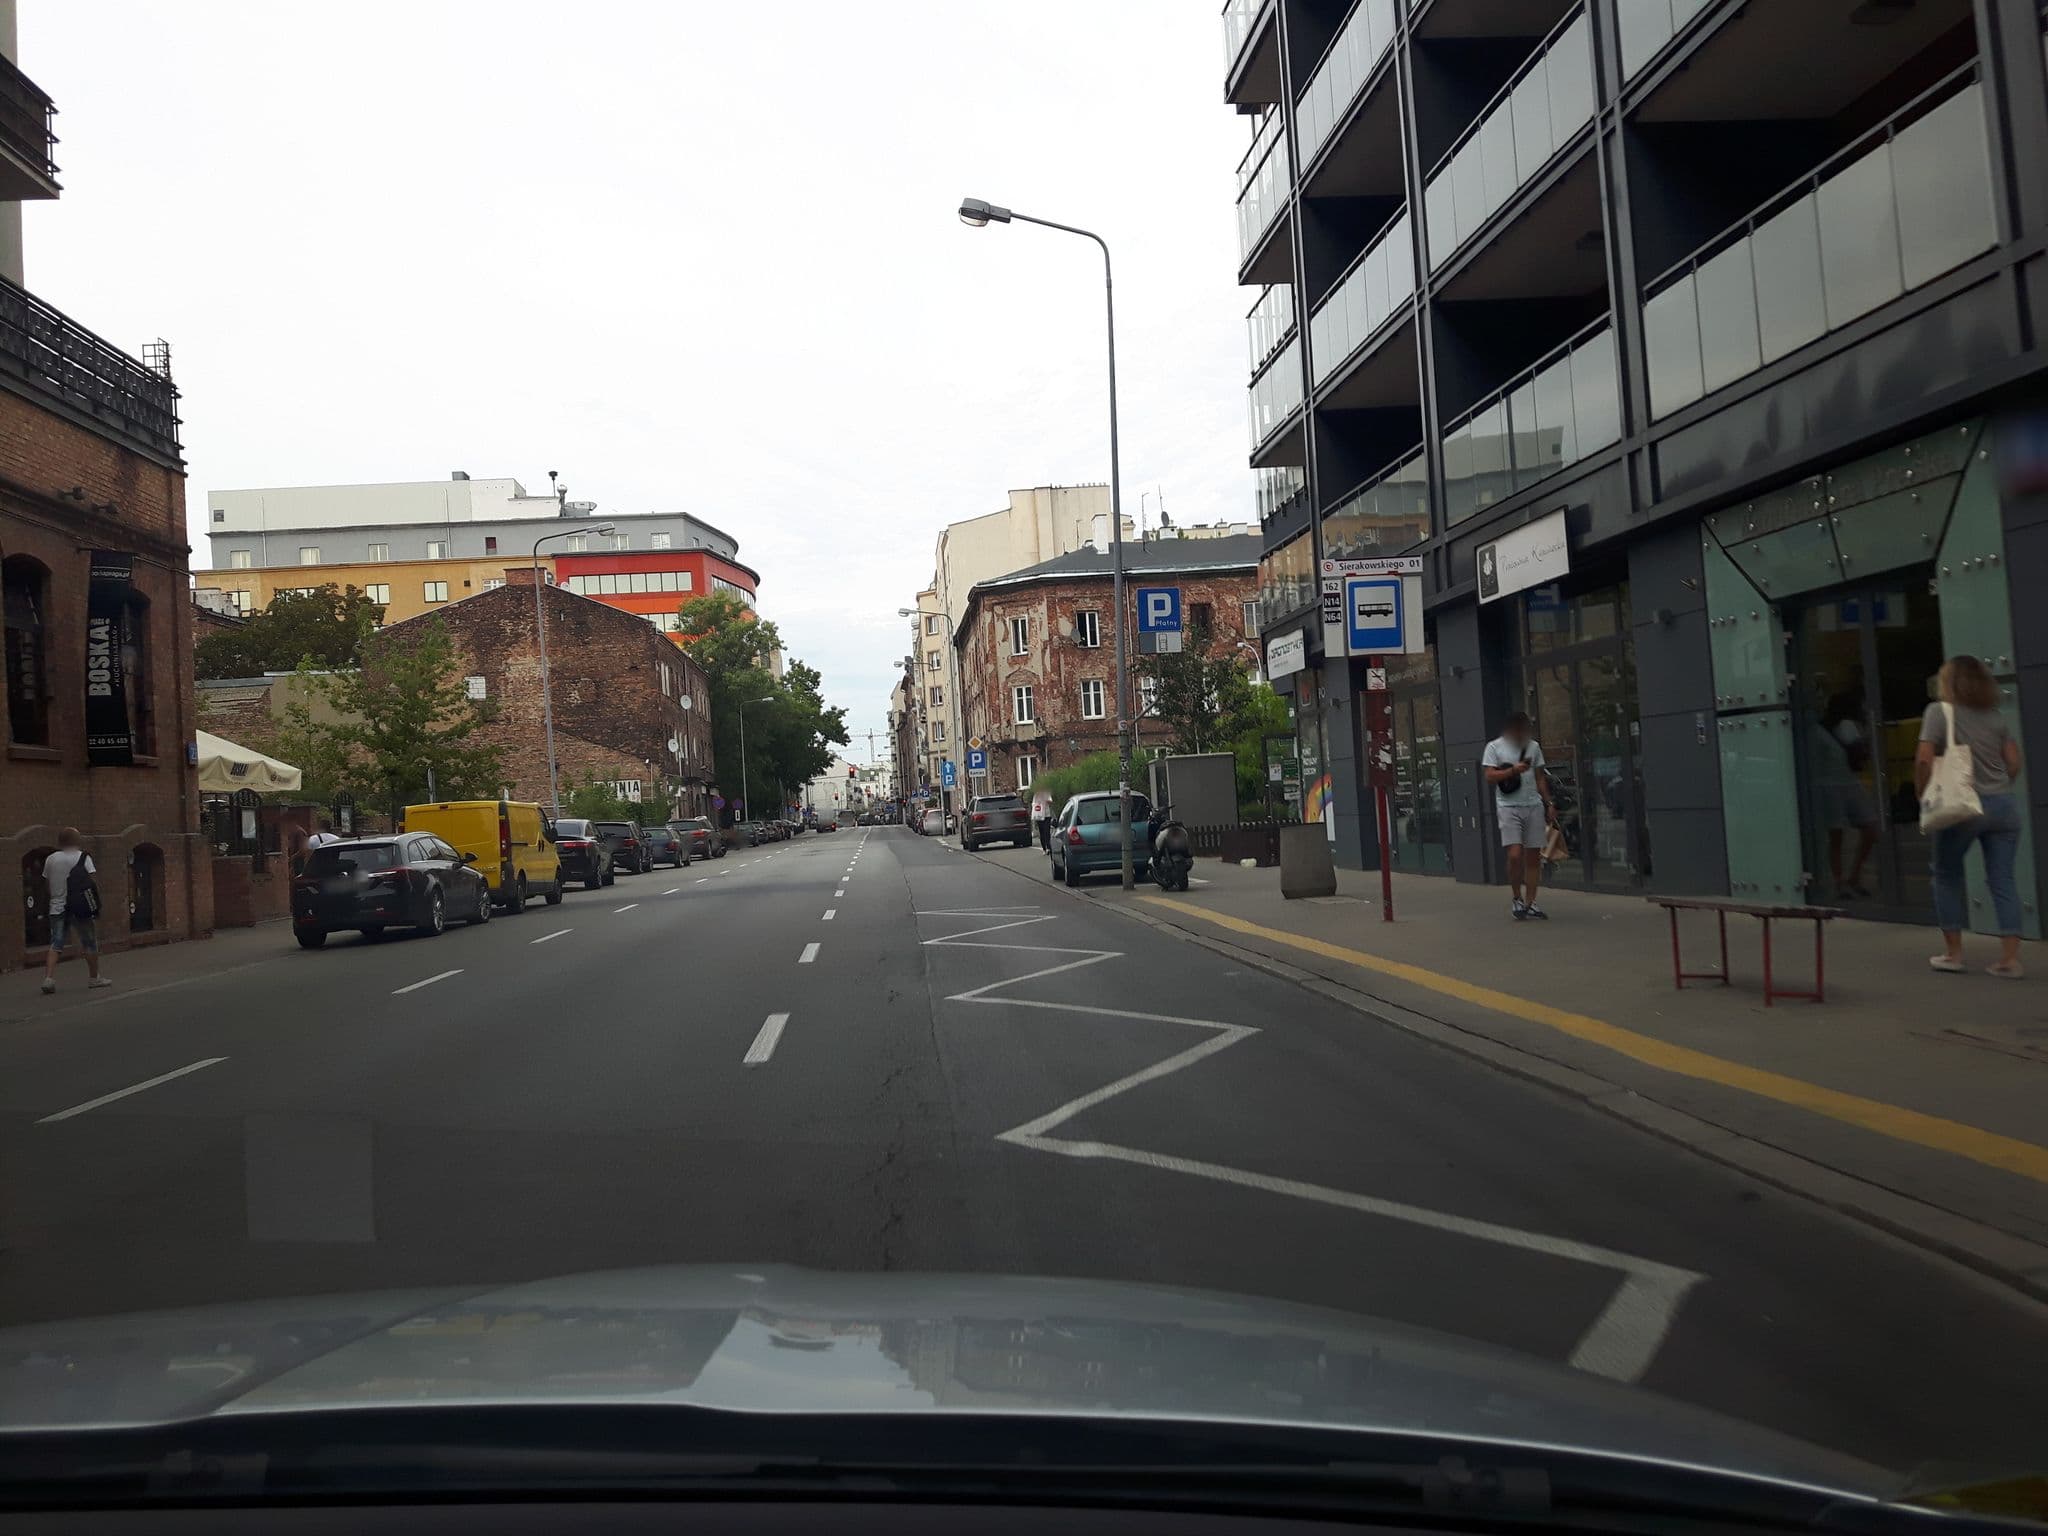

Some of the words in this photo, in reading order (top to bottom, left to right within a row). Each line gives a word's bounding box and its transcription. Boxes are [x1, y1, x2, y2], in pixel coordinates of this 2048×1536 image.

[1338, 560, 1405, 571] Sierakowskiego
[1409, 559, 1420, 568] 01
[1324, 582, 1339, 591] 162
[1324, 596, 1340, 607] N14
[1148, 593, 1172, 627] P
[1324, 613, 1341, 623] N64
[971, 752, 982, 767] P
[945, 774, 953, 784] P
